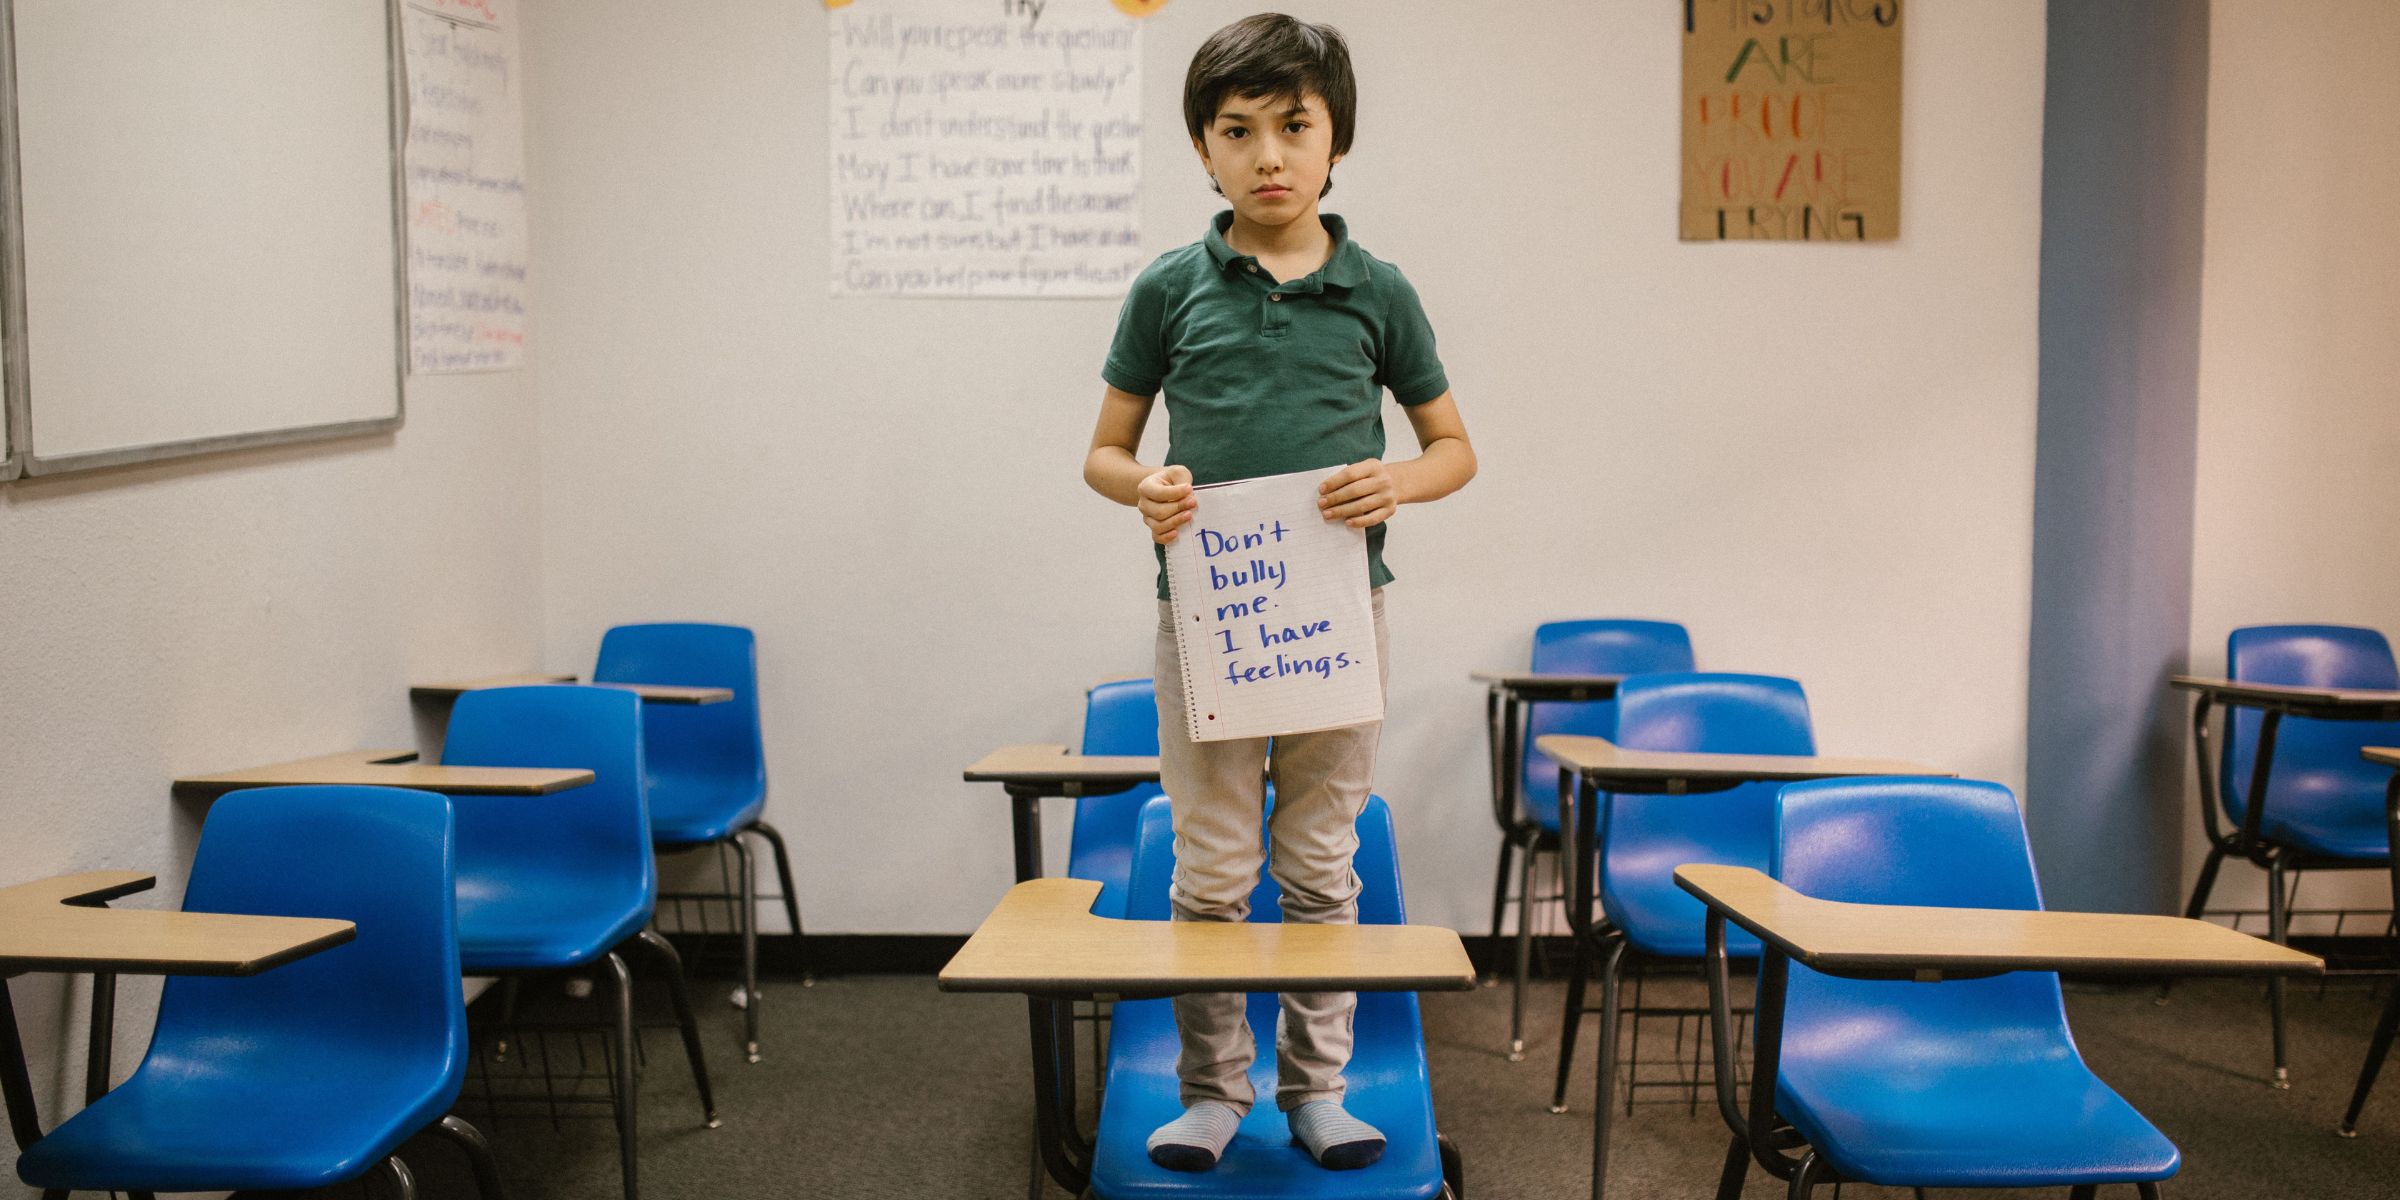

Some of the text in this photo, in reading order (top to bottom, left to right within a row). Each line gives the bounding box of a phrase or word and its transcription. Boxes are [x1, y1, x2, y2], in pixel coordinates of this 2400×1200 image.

[1725, 32, 1838, 85] ARE
[842, 58, 890, 98] Can
[892, 75, 924, 110] you
[841, 104, 868, 140] I
[1700, 88, 1858, 144] PROOF
[837, 153, 889, 194] May
[896, 152, 921, 182] I
[1775, 147, 1872, 204] ARE
[842, 190, 915, 222] Where
[959, 190, 985, 221] I
[1706, 203, 1865, 241] TRYING
[896, 230, 930, 250] not
[1028, 224, 1047, 251] I
[845, 258, 891, 291] Can
[1195, 520, 1291, 557] Don't
[1210, 559, 1287, 590] bully
[1216, 595, 1279, 622] me.
[1214, 620, 1332, 654] I have
[1225, 652, 1361, 686] feelings.
